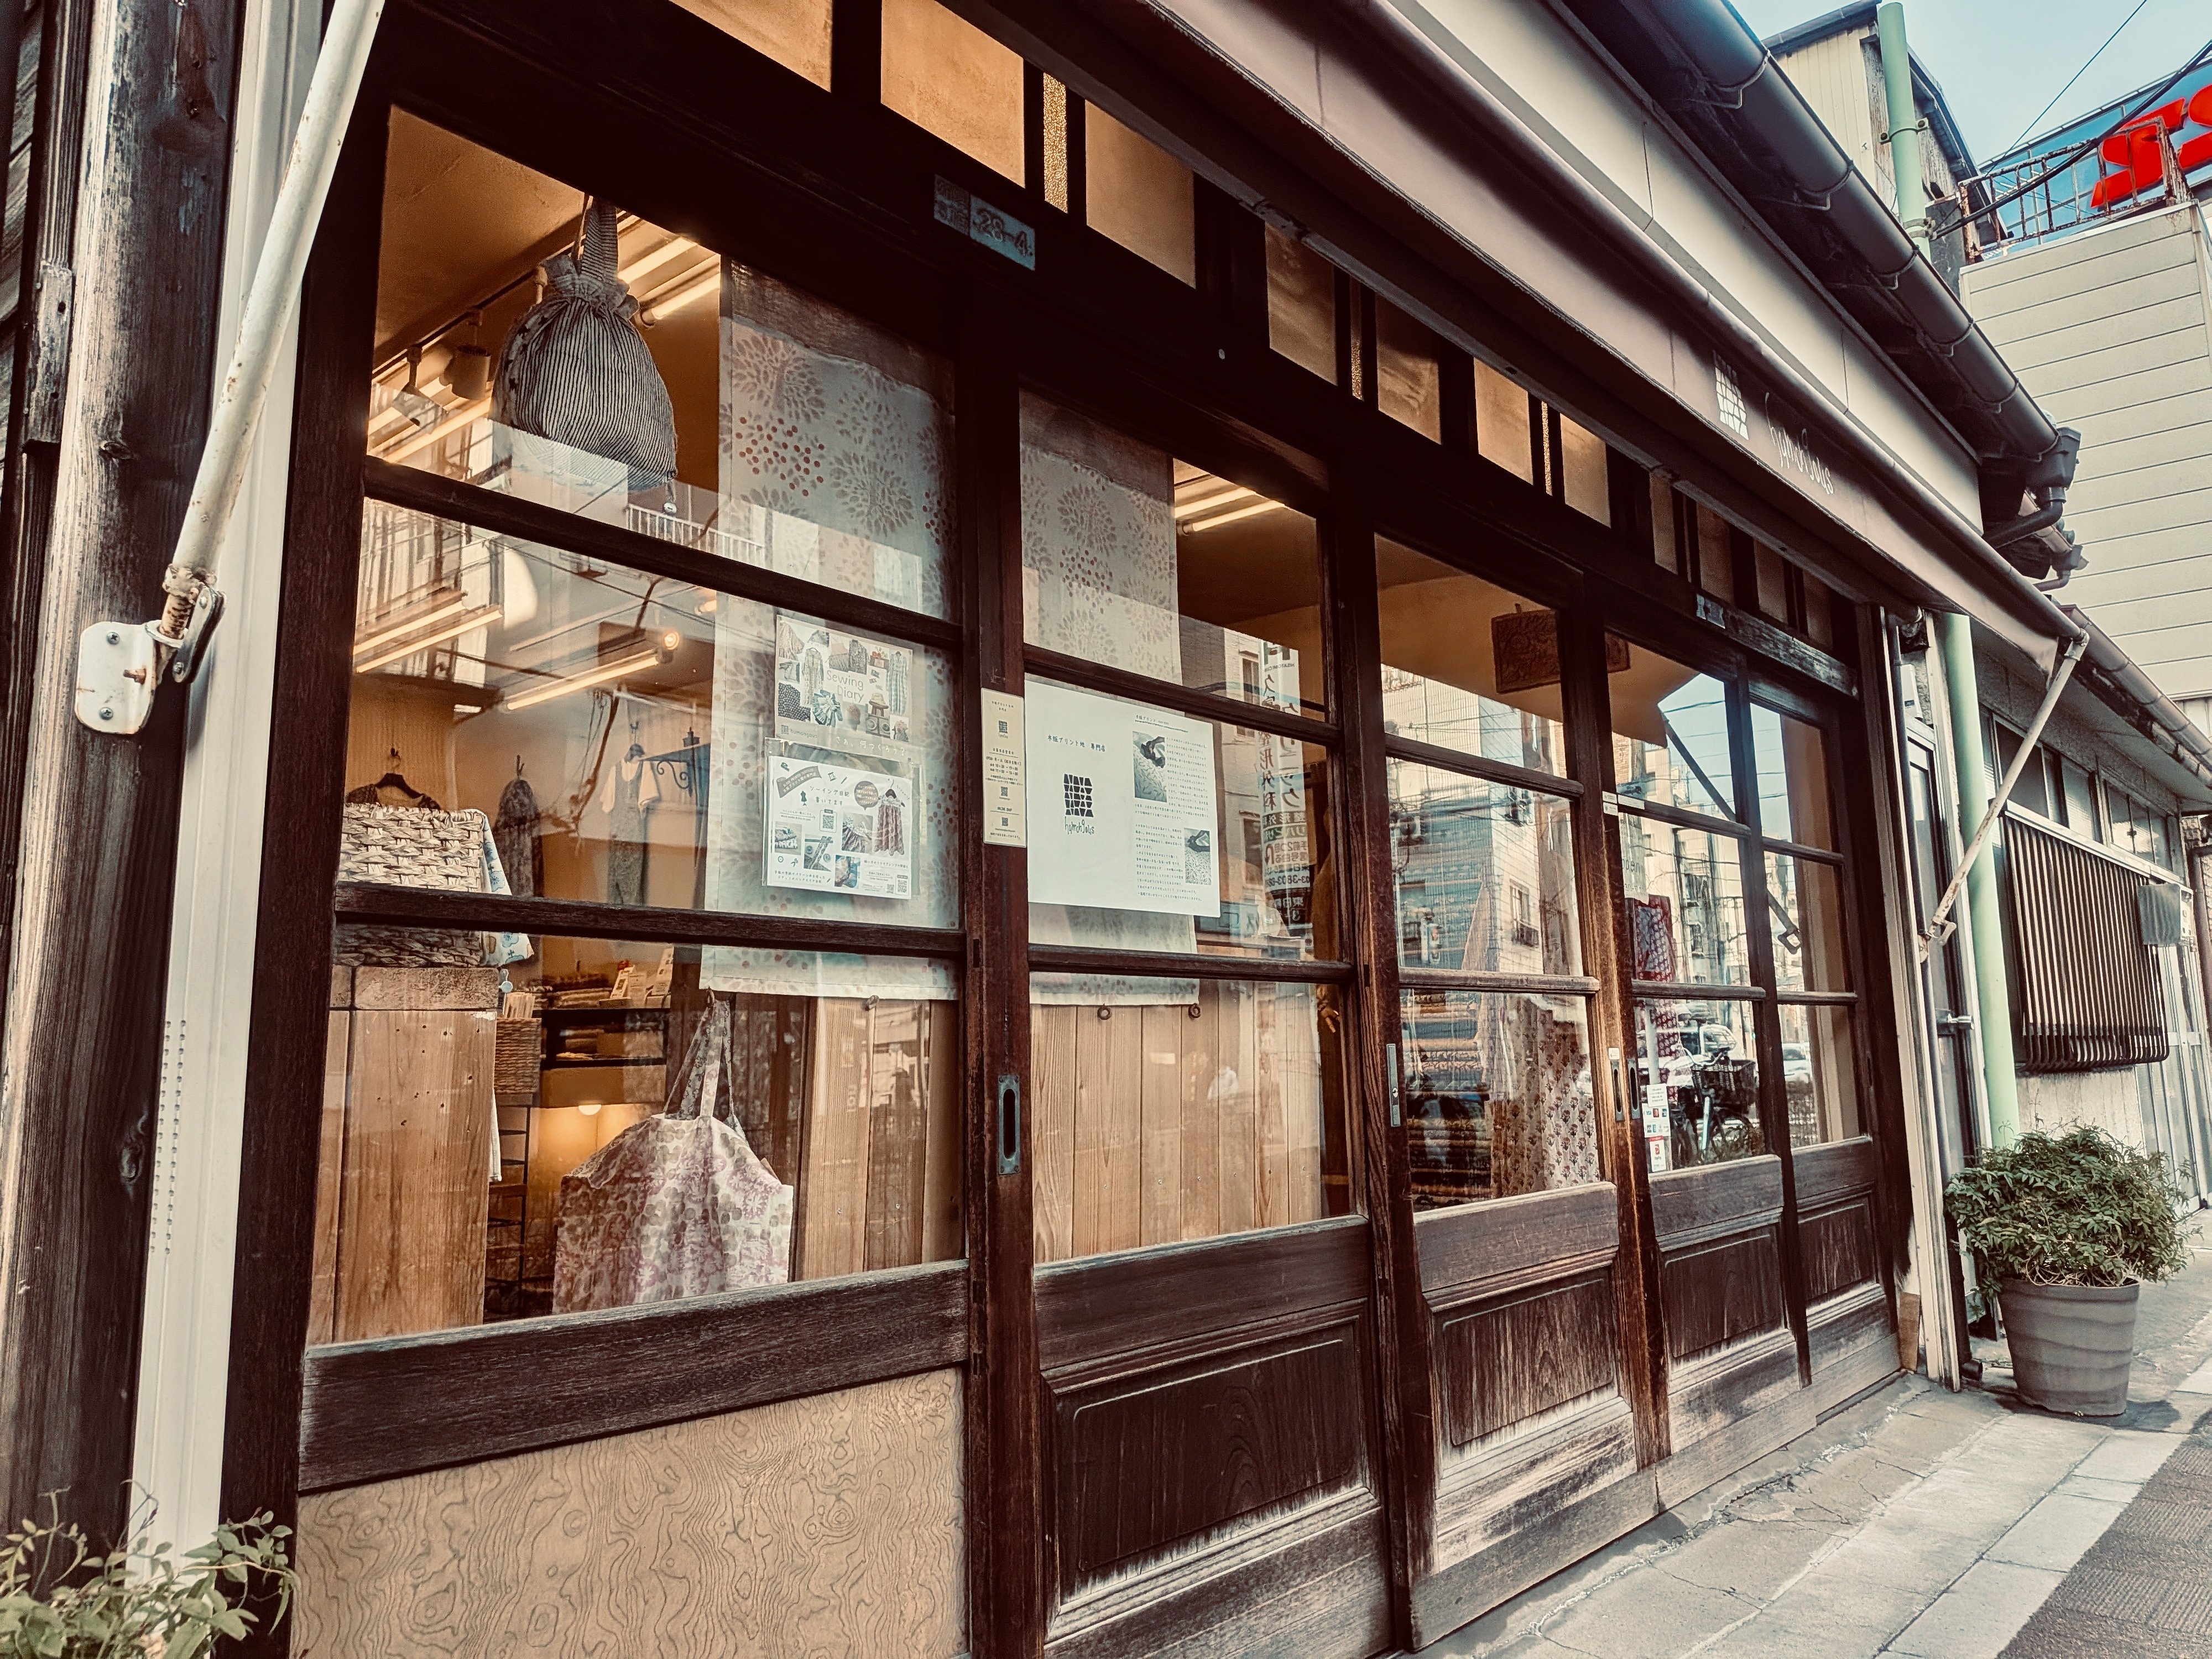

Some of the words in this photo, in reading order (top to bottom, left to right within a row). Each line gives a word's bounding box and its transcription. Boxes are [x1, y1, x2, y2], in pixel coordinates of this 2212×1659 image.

[827, 670, 864, 691] Sewing
[837, 685, 864, 703] Diary
[790, 729, 818, 739] humongous
[1091, 743, 1105, 752] 専門店
[810, 786, 849, 797] ソーイング日記
[816, 796, 843, 806] 書いてます
